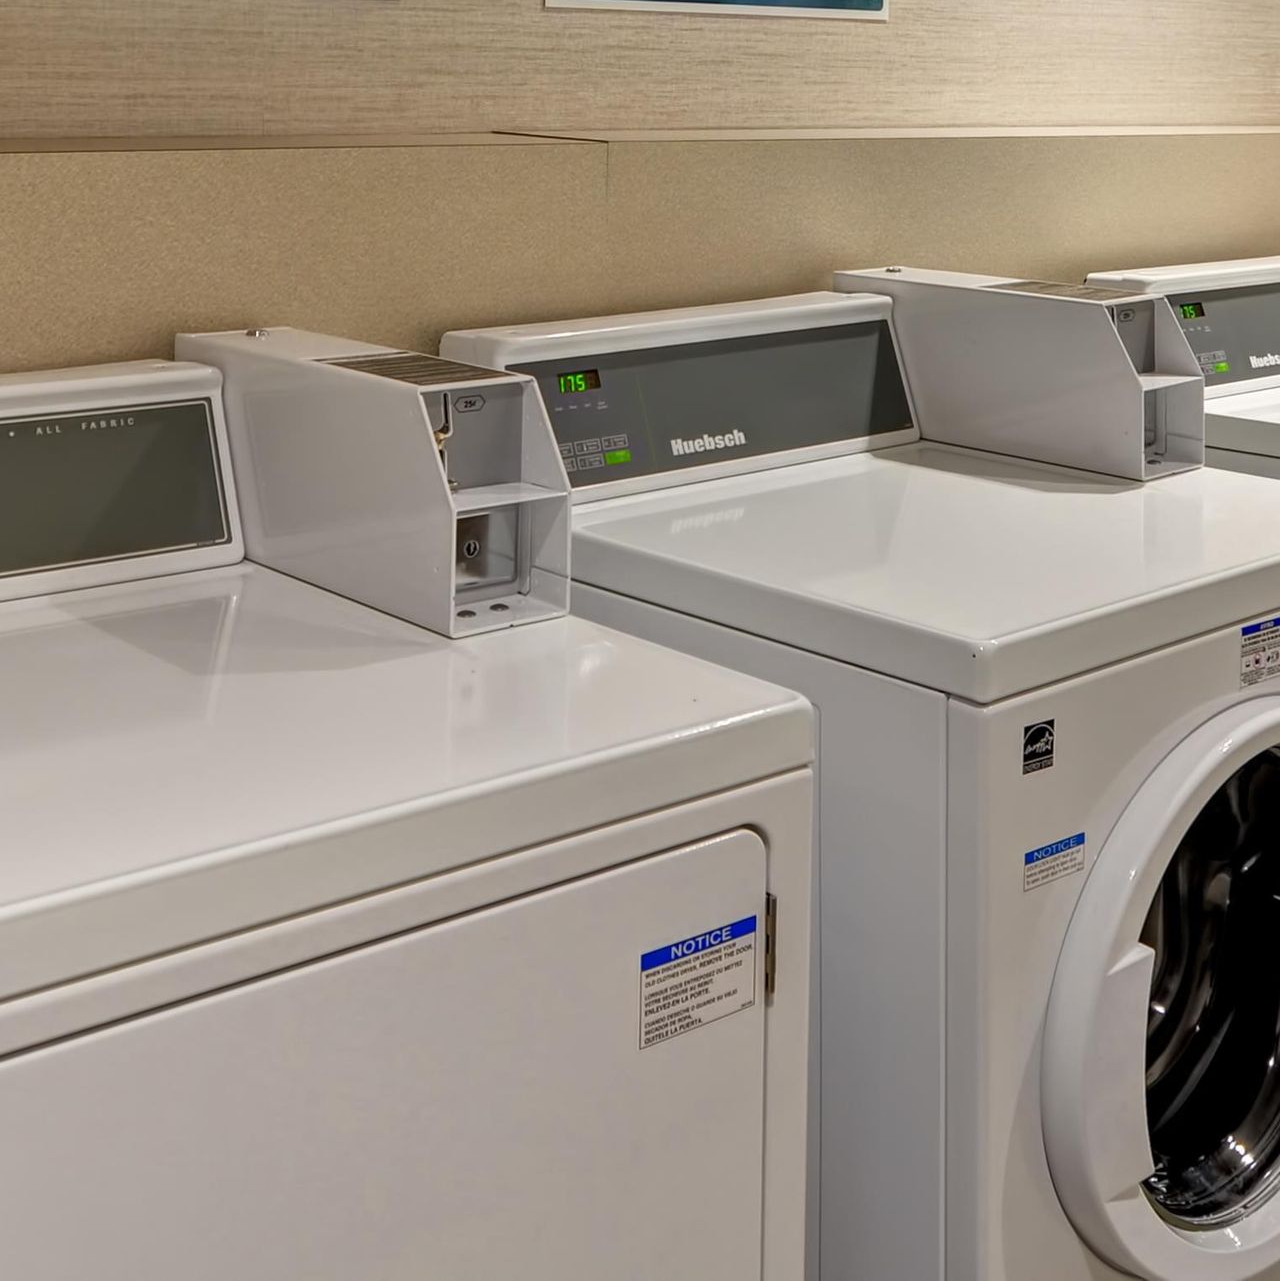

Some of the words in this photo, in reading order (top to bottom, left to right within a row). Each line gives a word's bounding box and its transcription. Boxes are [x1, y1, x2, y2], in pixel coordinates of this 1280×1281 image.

[560, 374, 586, 393] 175
[35, 424, 63, 435] ALL
[80, 417, 136, 431] FABRIC
[670, 429, 747, 456] Huebsch
[1033, 836, 1077, 861] NOTICE
[671, 926, 732, 959] NOTICE
